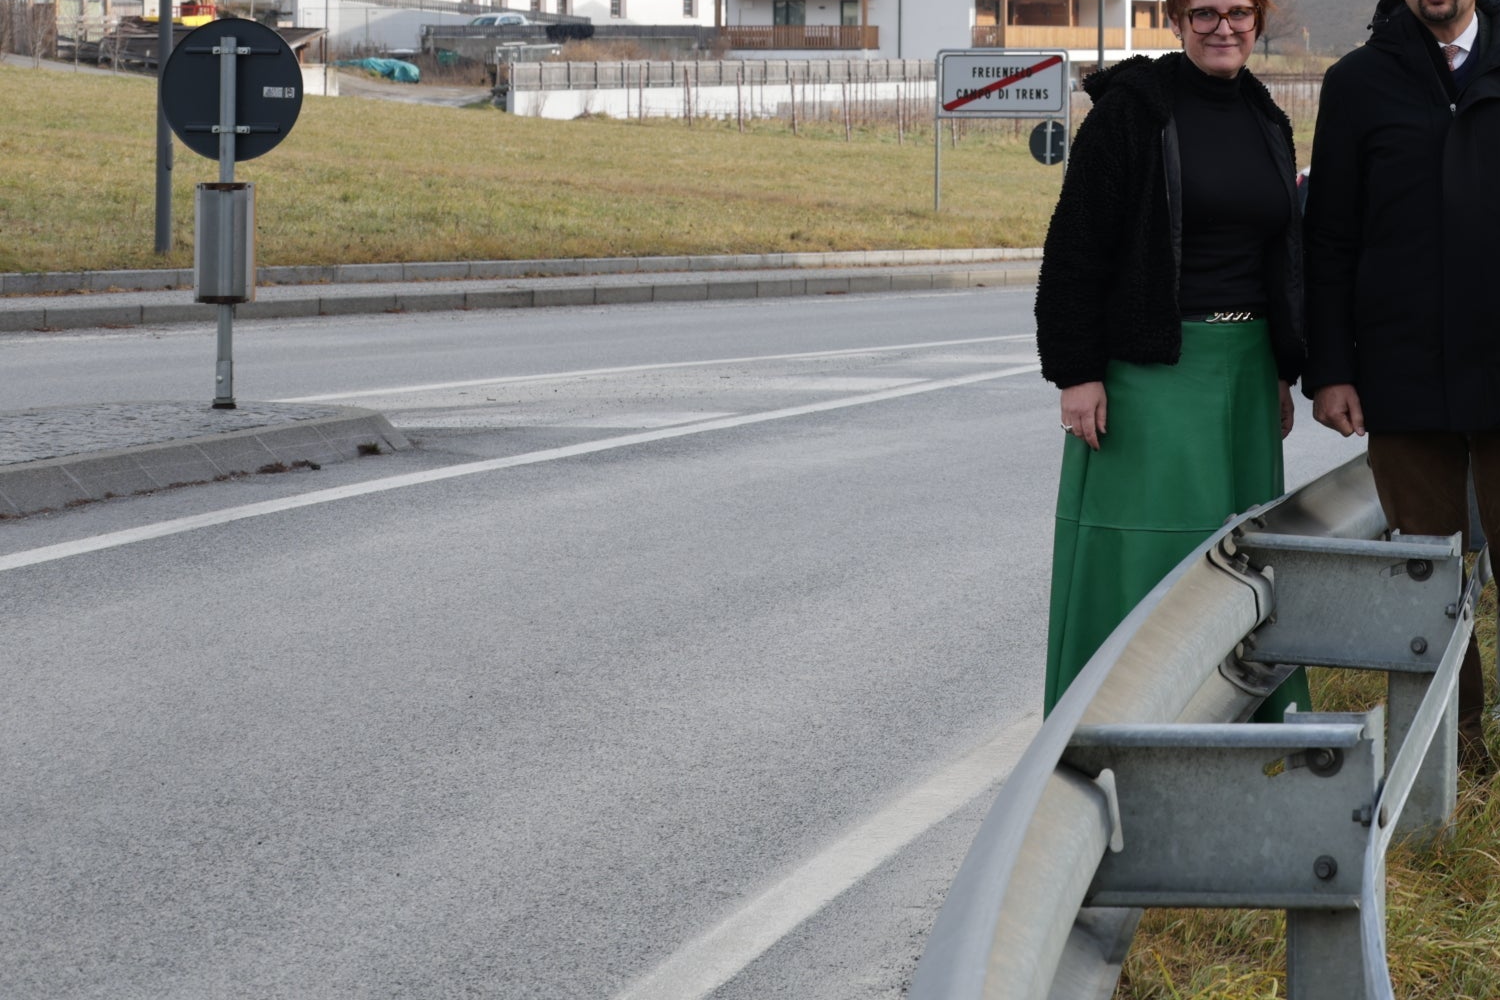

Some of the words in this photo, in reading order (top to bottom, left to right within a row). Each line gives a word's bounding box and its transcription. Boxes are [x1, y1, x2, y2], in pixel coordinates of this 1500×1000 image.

[972, 66, 1033, 79] FREIENFELD
[956, 88, 991, 100] CAMPO
[998, 88, 1009, 100] DI
[1016, 88, 1049, 100] TRENS
